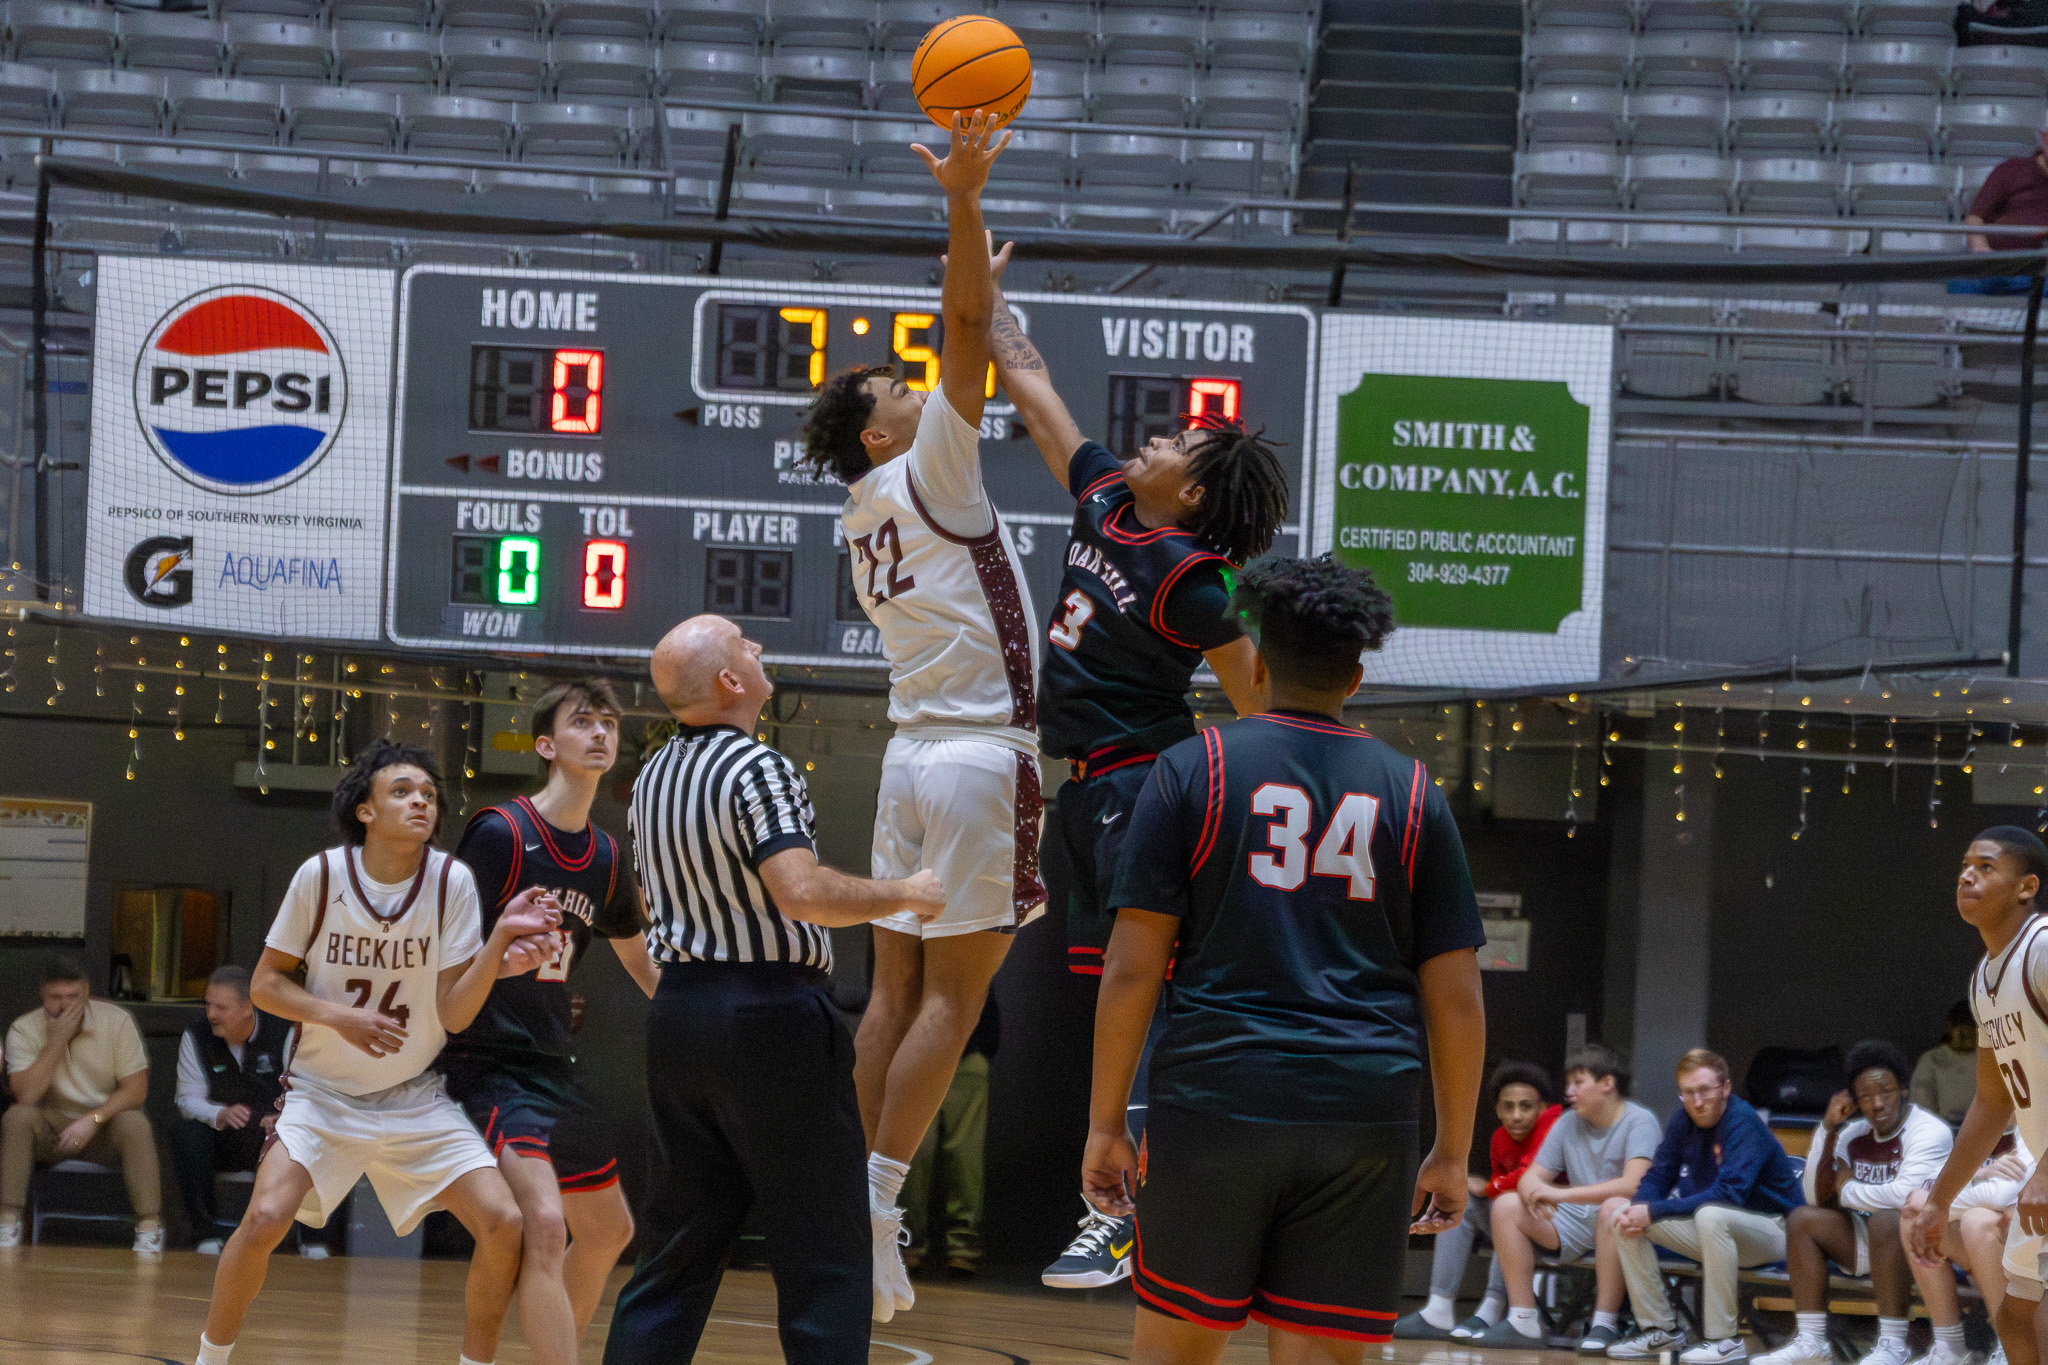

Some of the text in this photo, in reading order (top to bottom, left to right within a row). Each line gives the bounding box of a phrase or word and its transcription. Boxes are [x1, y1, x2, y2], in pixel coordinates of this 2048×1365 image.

[481, 287, 598, 332] HOME
[1102, 317, 1255, 364] VISITOR
[150, 366, 330, 415] PEPSI
[551, 348, 603, 434] 0
[704, 404, 761, 428] POSS
[506, 449, 603, 482] BONUS
[108, 506, 363, 530] PEPSICO OF SOUTHERN WEST VIRGINIA
[457, 502, 541, 533] FOULS
[579, 507, 634, 537] TOL
[693, 512, 799, 544] PLAYER
[1340, 527, 1576, 557] CERTIFIED PUBLIC ACCOUNTANT
[123, 535, 193, 610] G
[218, 552, 343, 596] AQUAFINA
[498, 536, 541, 606] 0
[583, 539, 628, 609] 0
[1407, 562, 1510, 586] 304-929-4377
[461, 611, 522, 638] WON
[1048, 588, 1095, 652] 3
[1248, 782, 1380, 902] 34
[326, 932, 431, 971] BECKLEY
